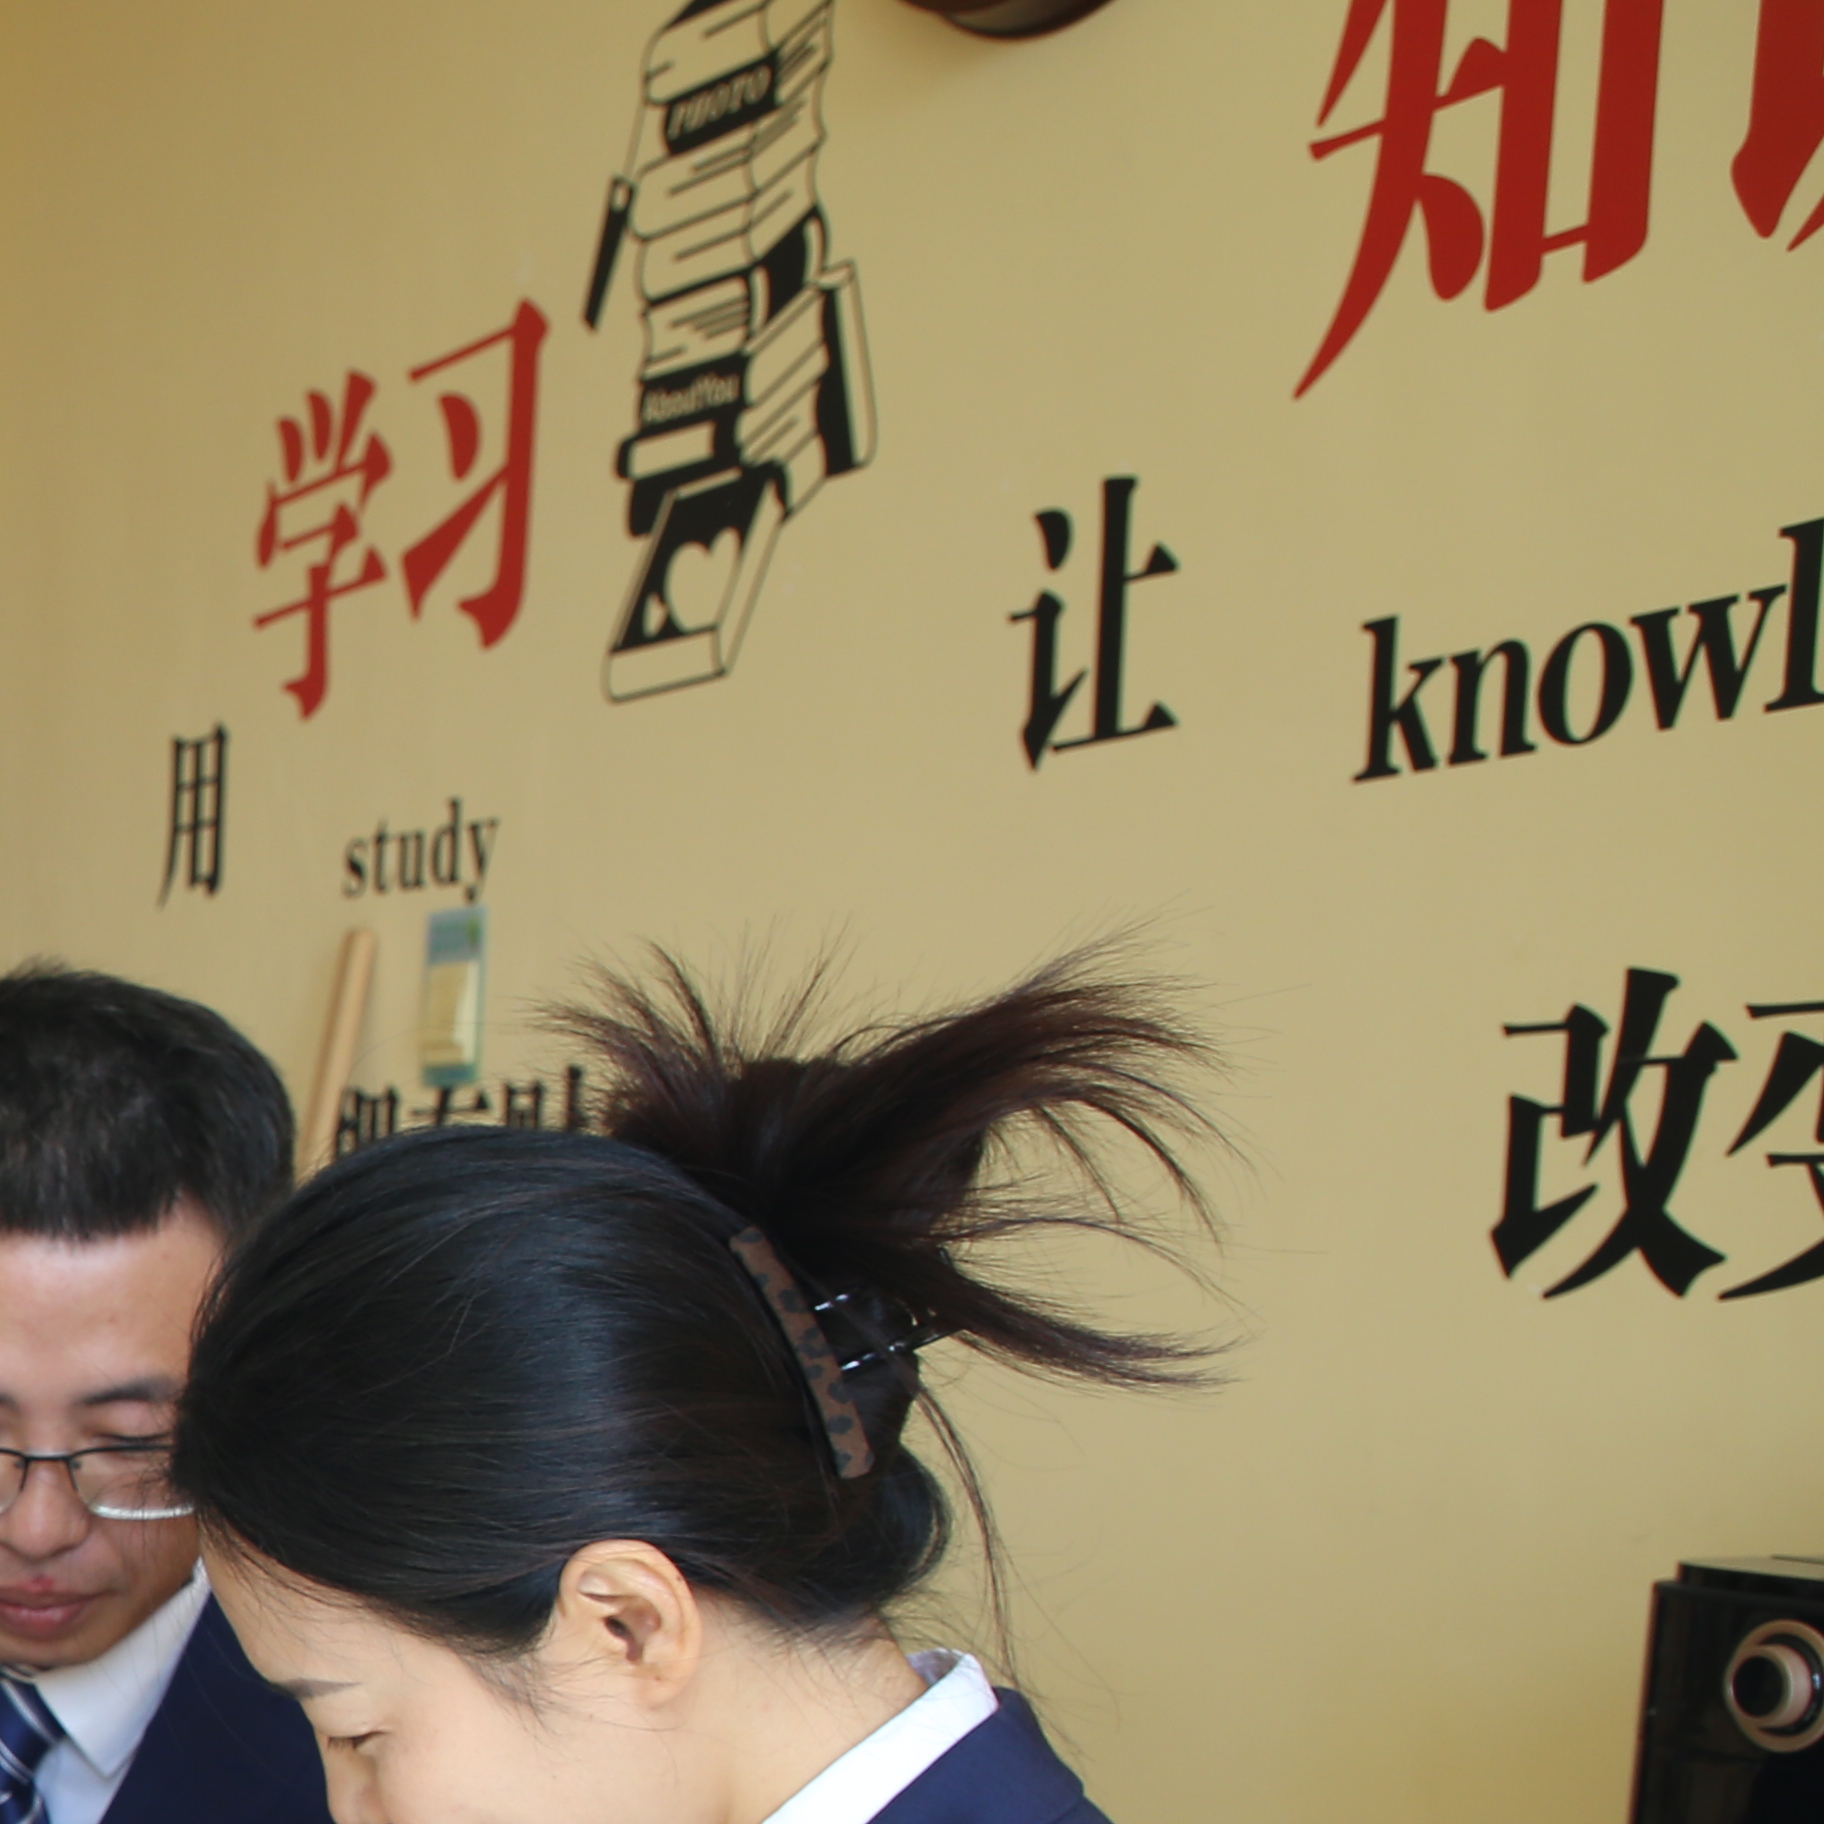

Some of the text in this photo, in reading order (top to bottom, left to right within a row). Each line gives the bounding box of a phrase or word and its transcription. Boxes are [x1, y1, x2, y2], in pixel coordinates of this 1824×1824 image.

[1294, 0, 1824, 400] 知
[255, 299, 548, 721] 学习
[1008, 474, 1179, 772] 让
[159, 722, 230, 907] 用
[342, 797, 500, 903] study
